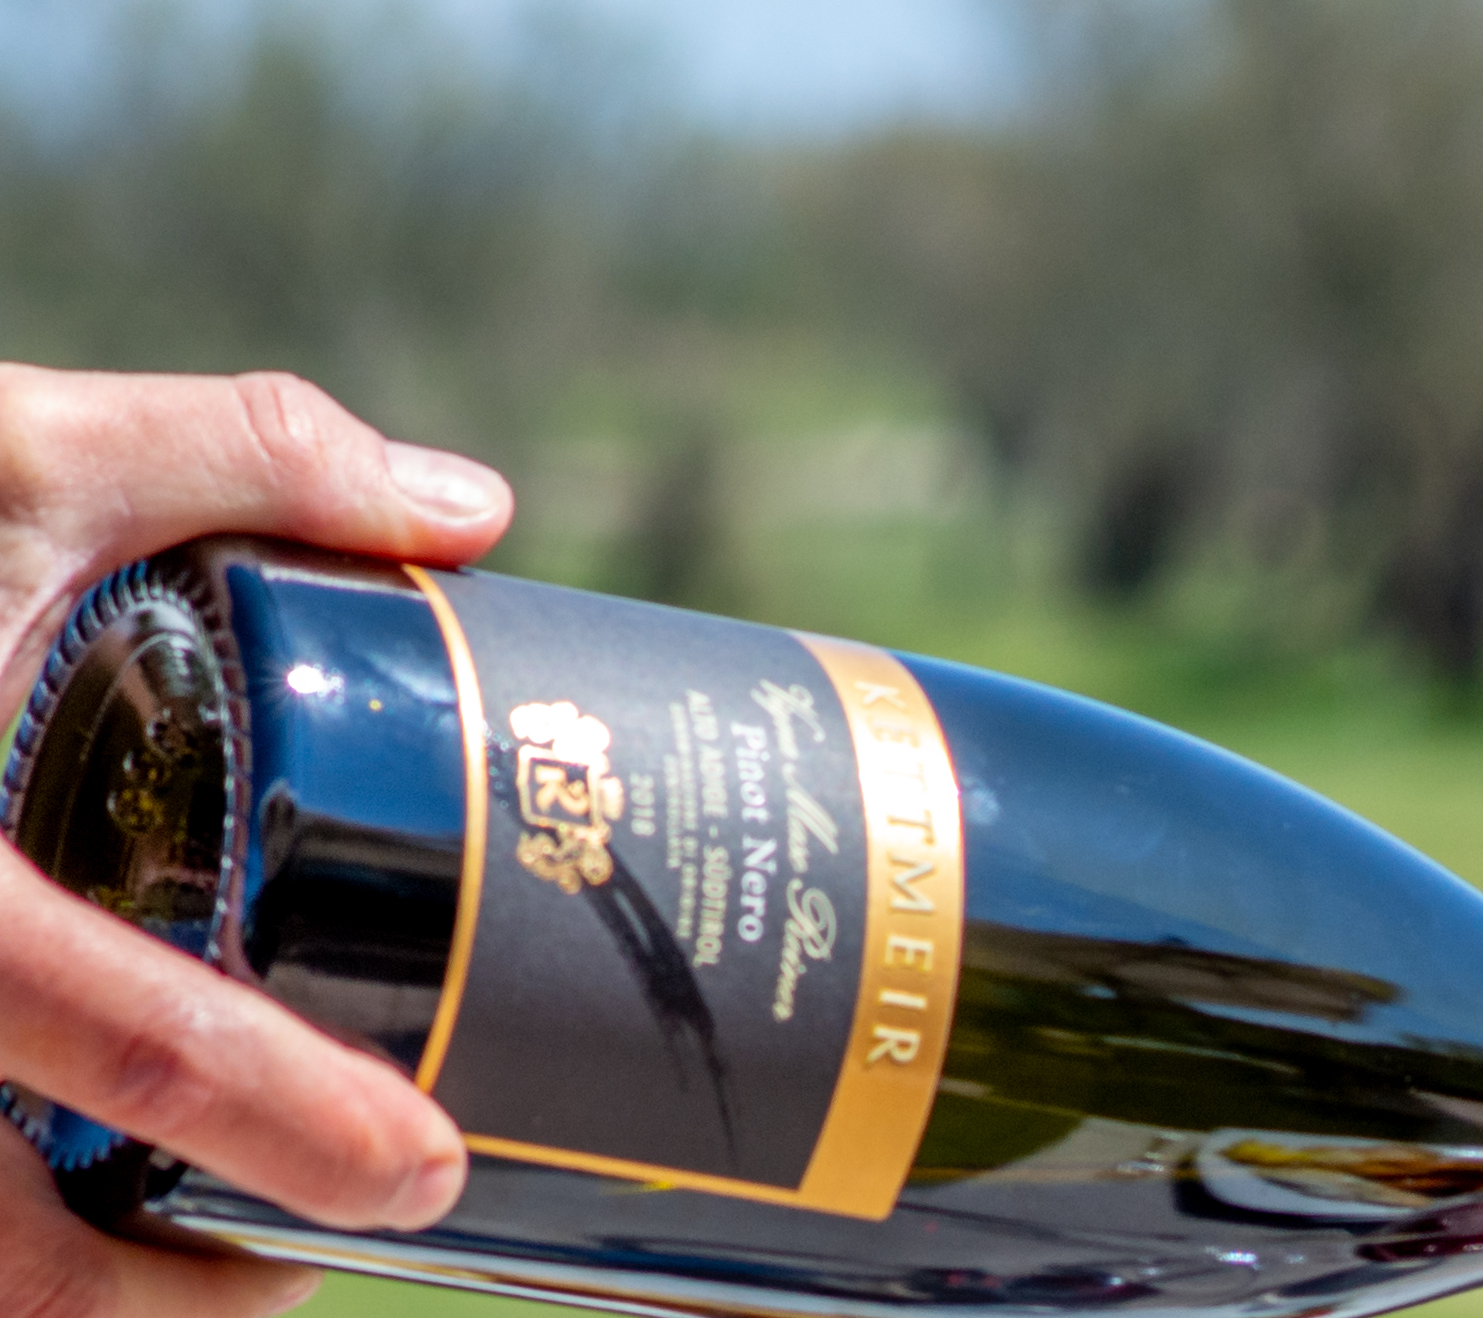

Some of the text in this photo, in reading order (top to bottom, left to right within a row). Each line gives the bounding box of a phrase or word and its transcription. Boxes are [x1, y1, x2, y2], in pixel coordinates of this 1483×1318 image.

[685, 689, 719, 740] ALTO
[630, 773, 656, 836] 2018
[698, 744, 728, 818] ADIGE
[730, 721, 778, 943] Pinot Nero
[853, 680, 938, 1067] KETTMEIR
[691, 844, 732, 966] SÜDTIROL
